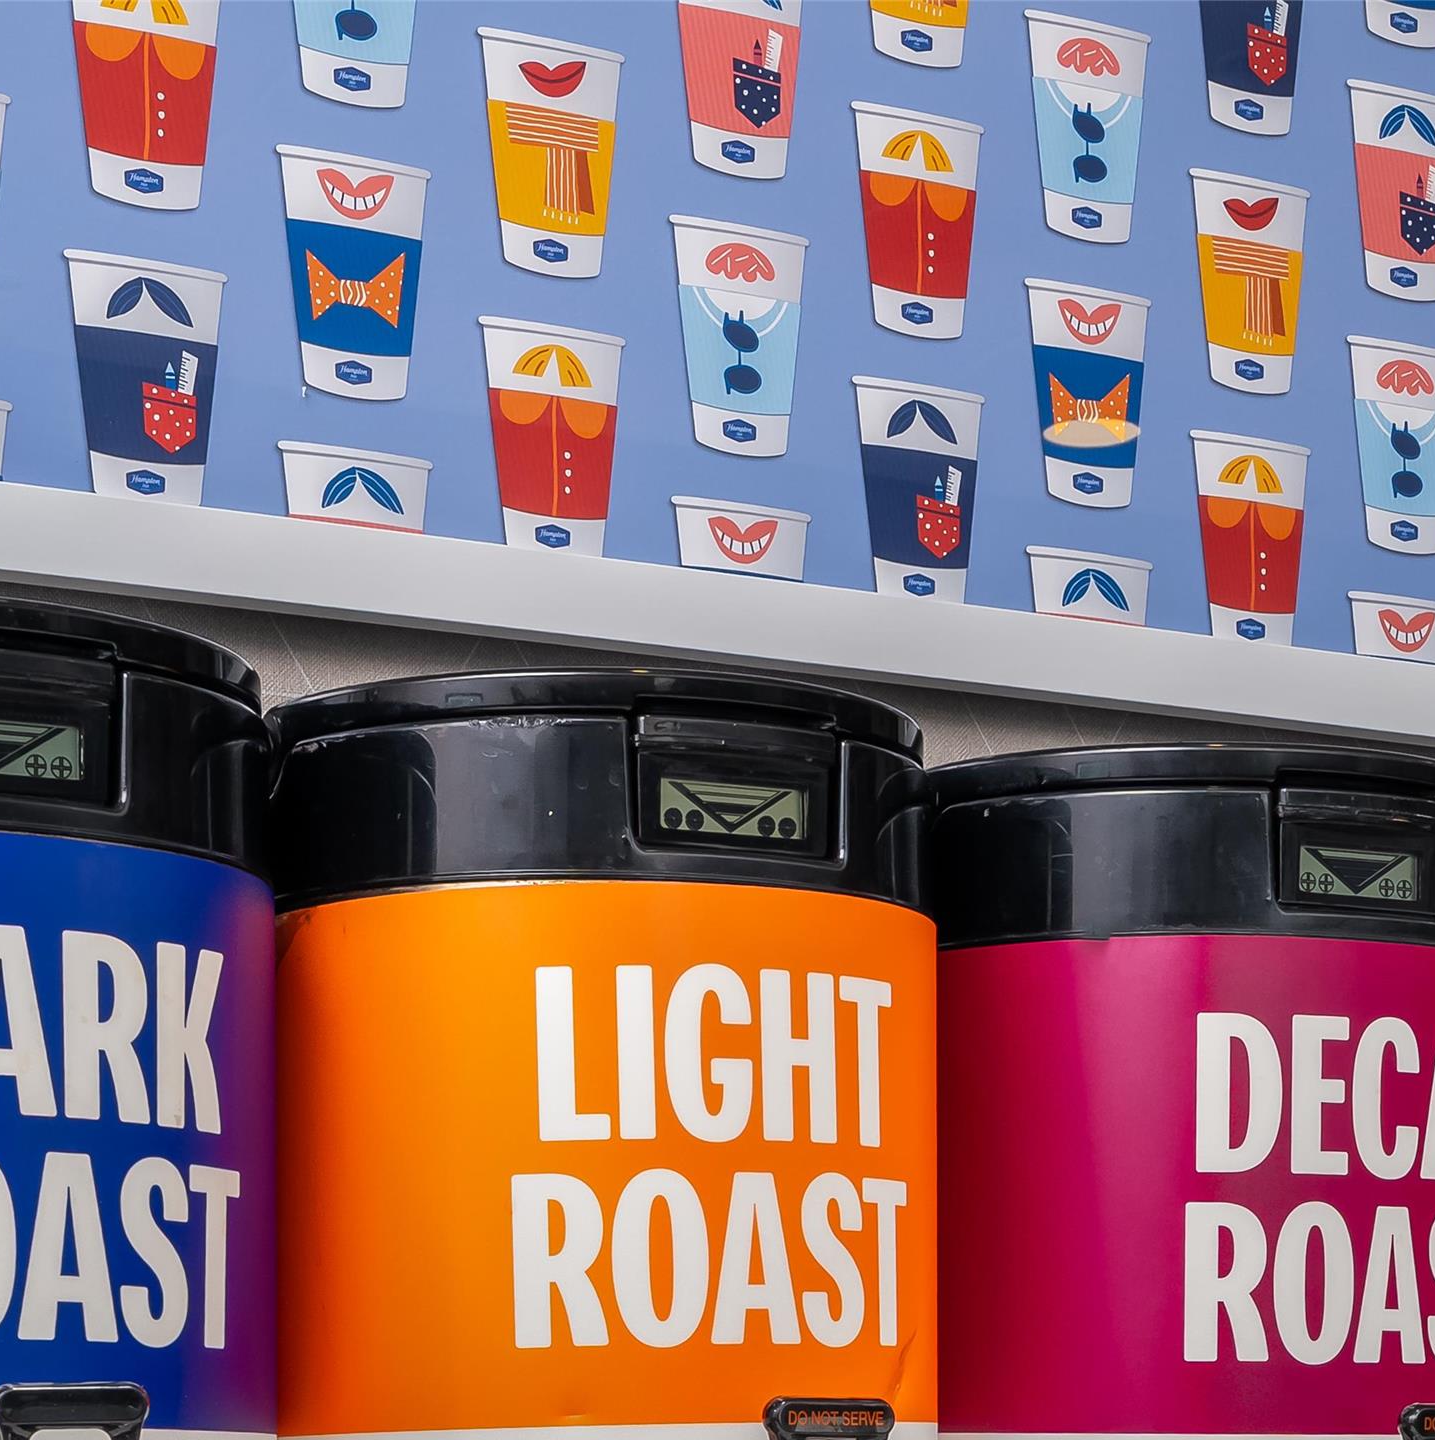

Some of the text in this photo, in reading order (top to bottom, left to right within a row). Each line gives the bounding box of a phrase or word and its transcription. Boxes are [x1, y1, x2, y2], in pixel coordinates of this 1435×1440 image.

[535, 963, 892, 1147] LIGHT
[511, 1168, 907, 1349] ROAST
[788, 1411, 884, 1426] DO NOT SERVE
